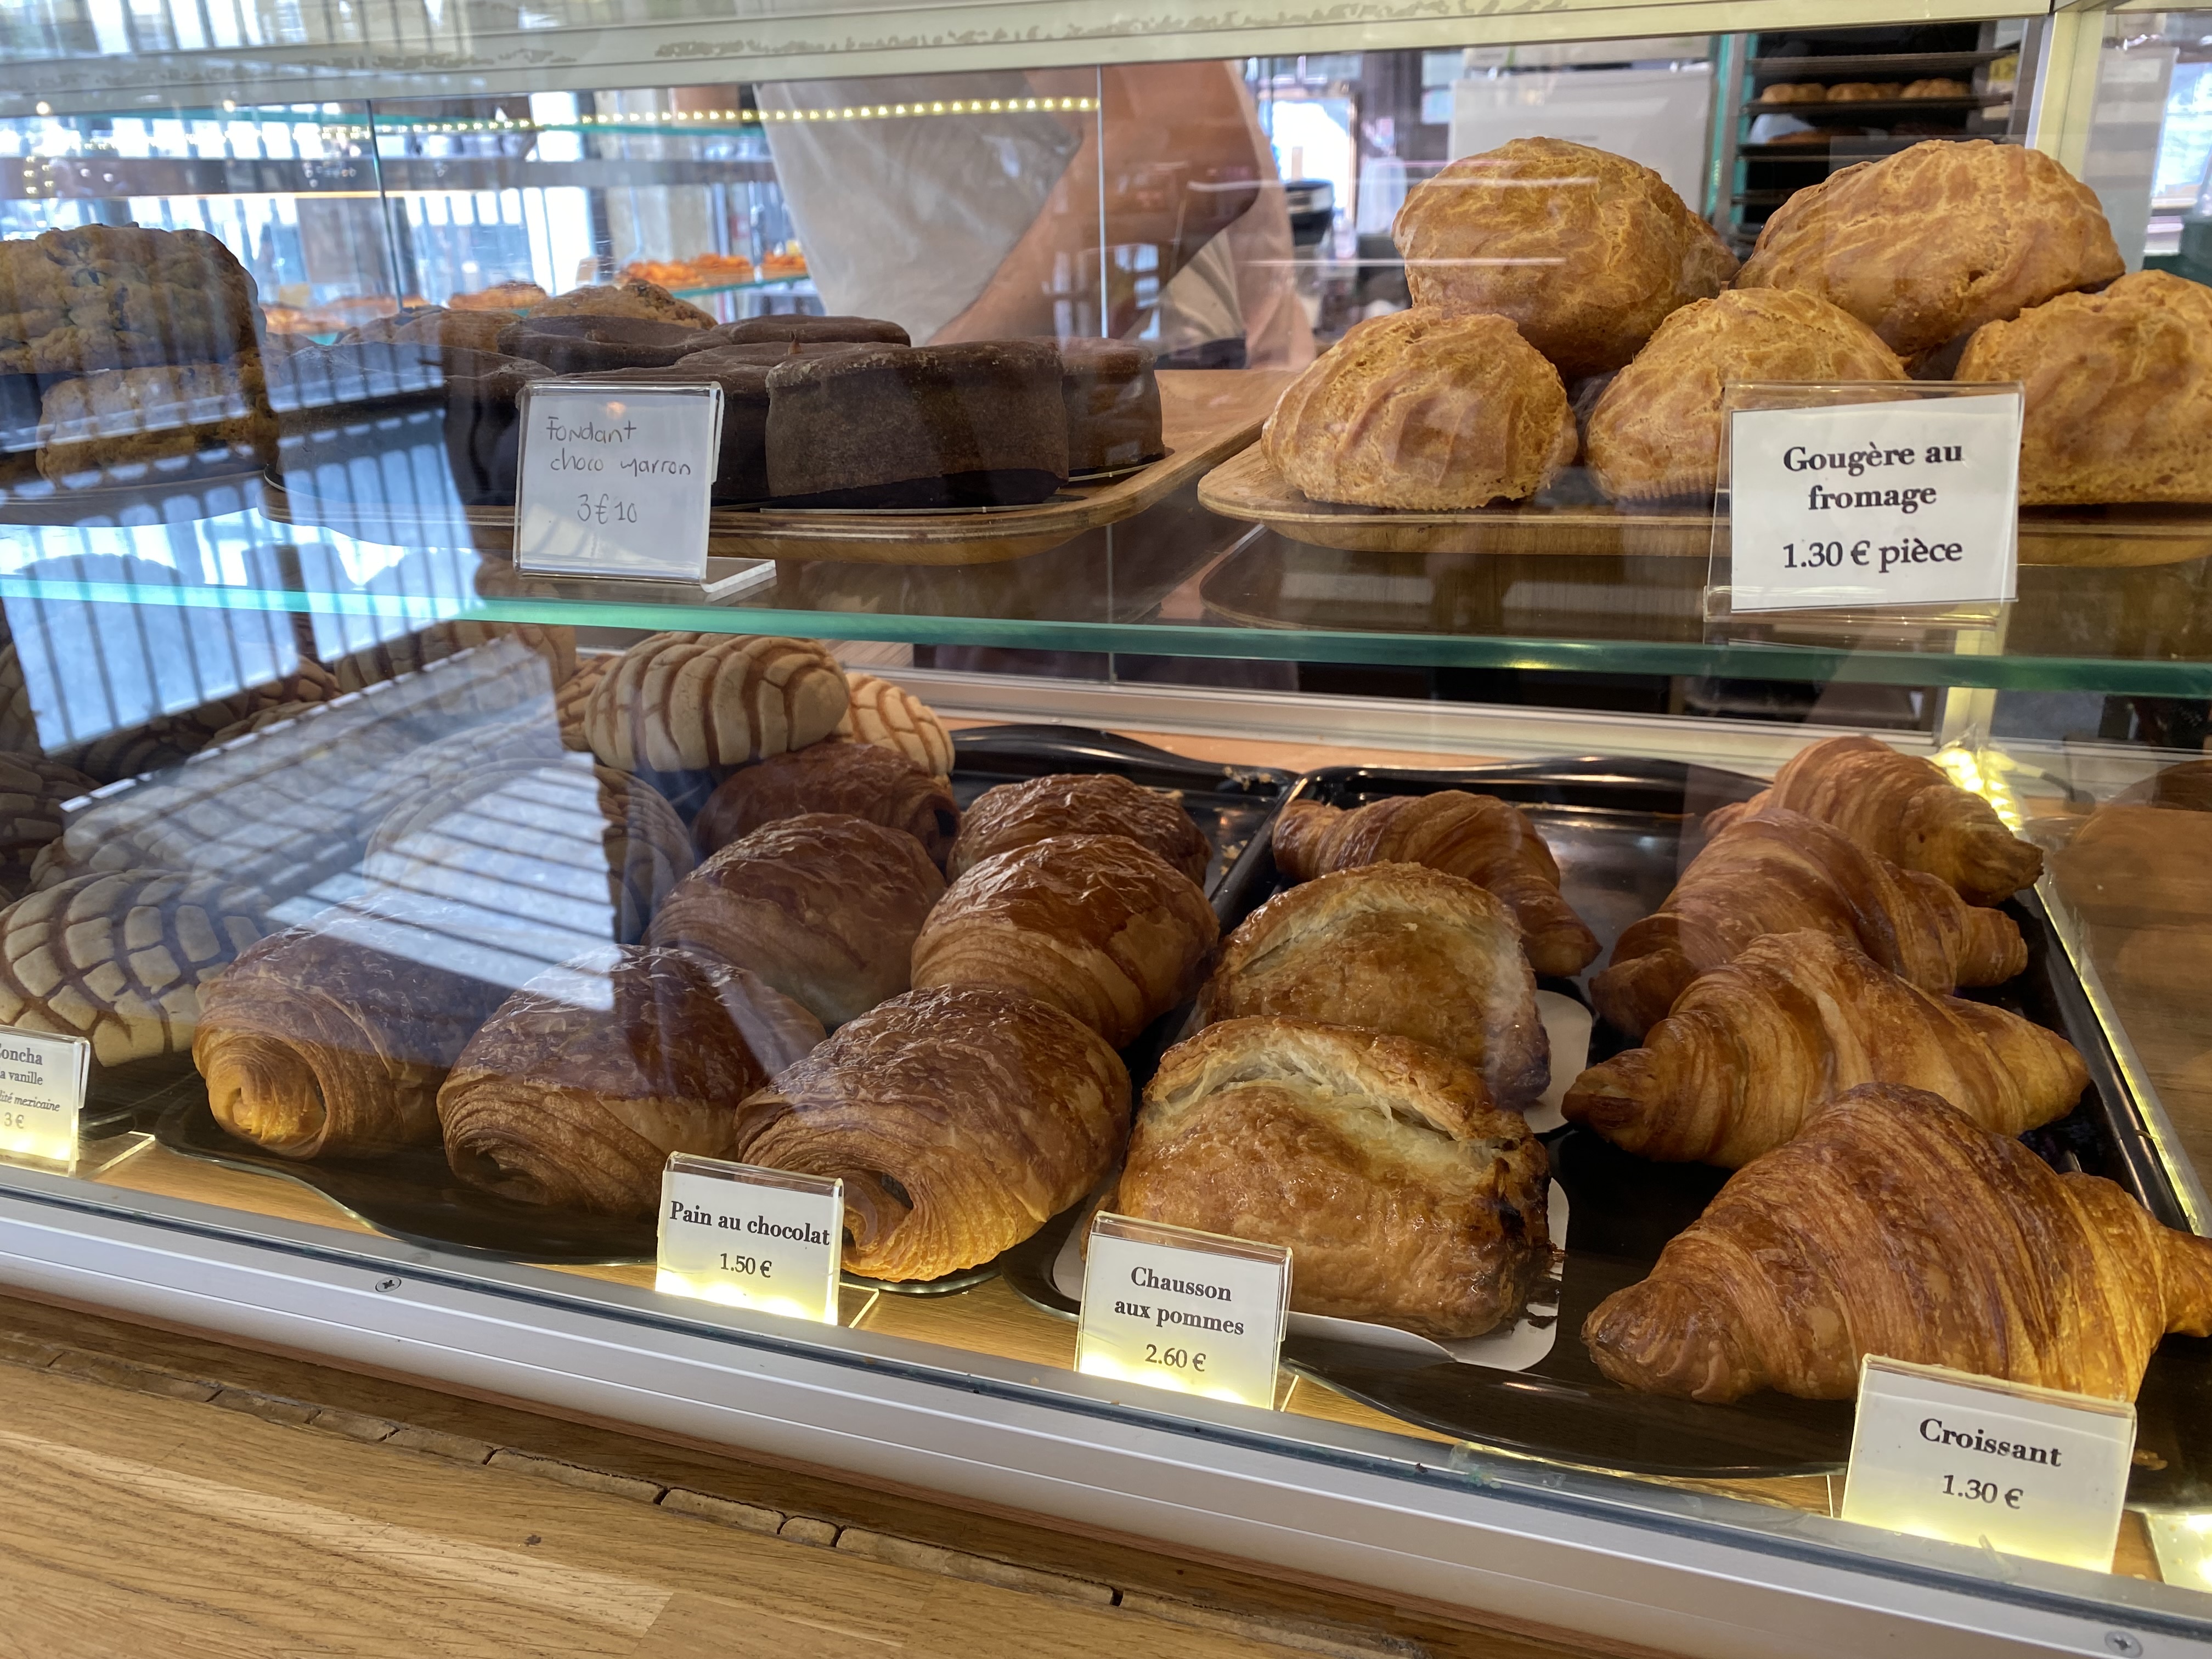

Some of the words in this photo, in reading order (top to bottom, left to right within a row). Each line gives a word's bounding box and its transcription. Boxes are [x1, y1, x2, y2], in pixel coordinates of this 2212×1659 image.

[550, 448, 604, 471] choco
[1783, 442, 1915, 476] Gougère
[1925, 445, 1963, 463] au
[1808, 485, 1937, 514] fromage
[1783, 541, 1843, 568] 1.30
[1850, 540, 1871, 566] €
[1878, 538, 1963, 574] pièce
[8, 1071, 43, 1085] vanille
[4, 1111, 13, 1127] 3
[669, 1200, 712, 1226] Pain
[718, 1215, 741, 1231] au
[747, 1215, 830, 1245] chocolat
[720, 1253, 756, 1275] 1.50
[760, 1260, 772, 1278] €
[1131, 1266, 1232, 1302] Chausson
[1114, 1300, 1150, 1319] aux
[1156, 1308, 1244, 1335] pommes
[1145, 1344, 1187, 1368] 2.60
[1192, 1353, 1206, 1372] €
[1920, 1418, 2062, 1467] Croissant
[1942, 1475, 1998, 1504] 1.30
[2005, 1488, 2024, 1510] €
